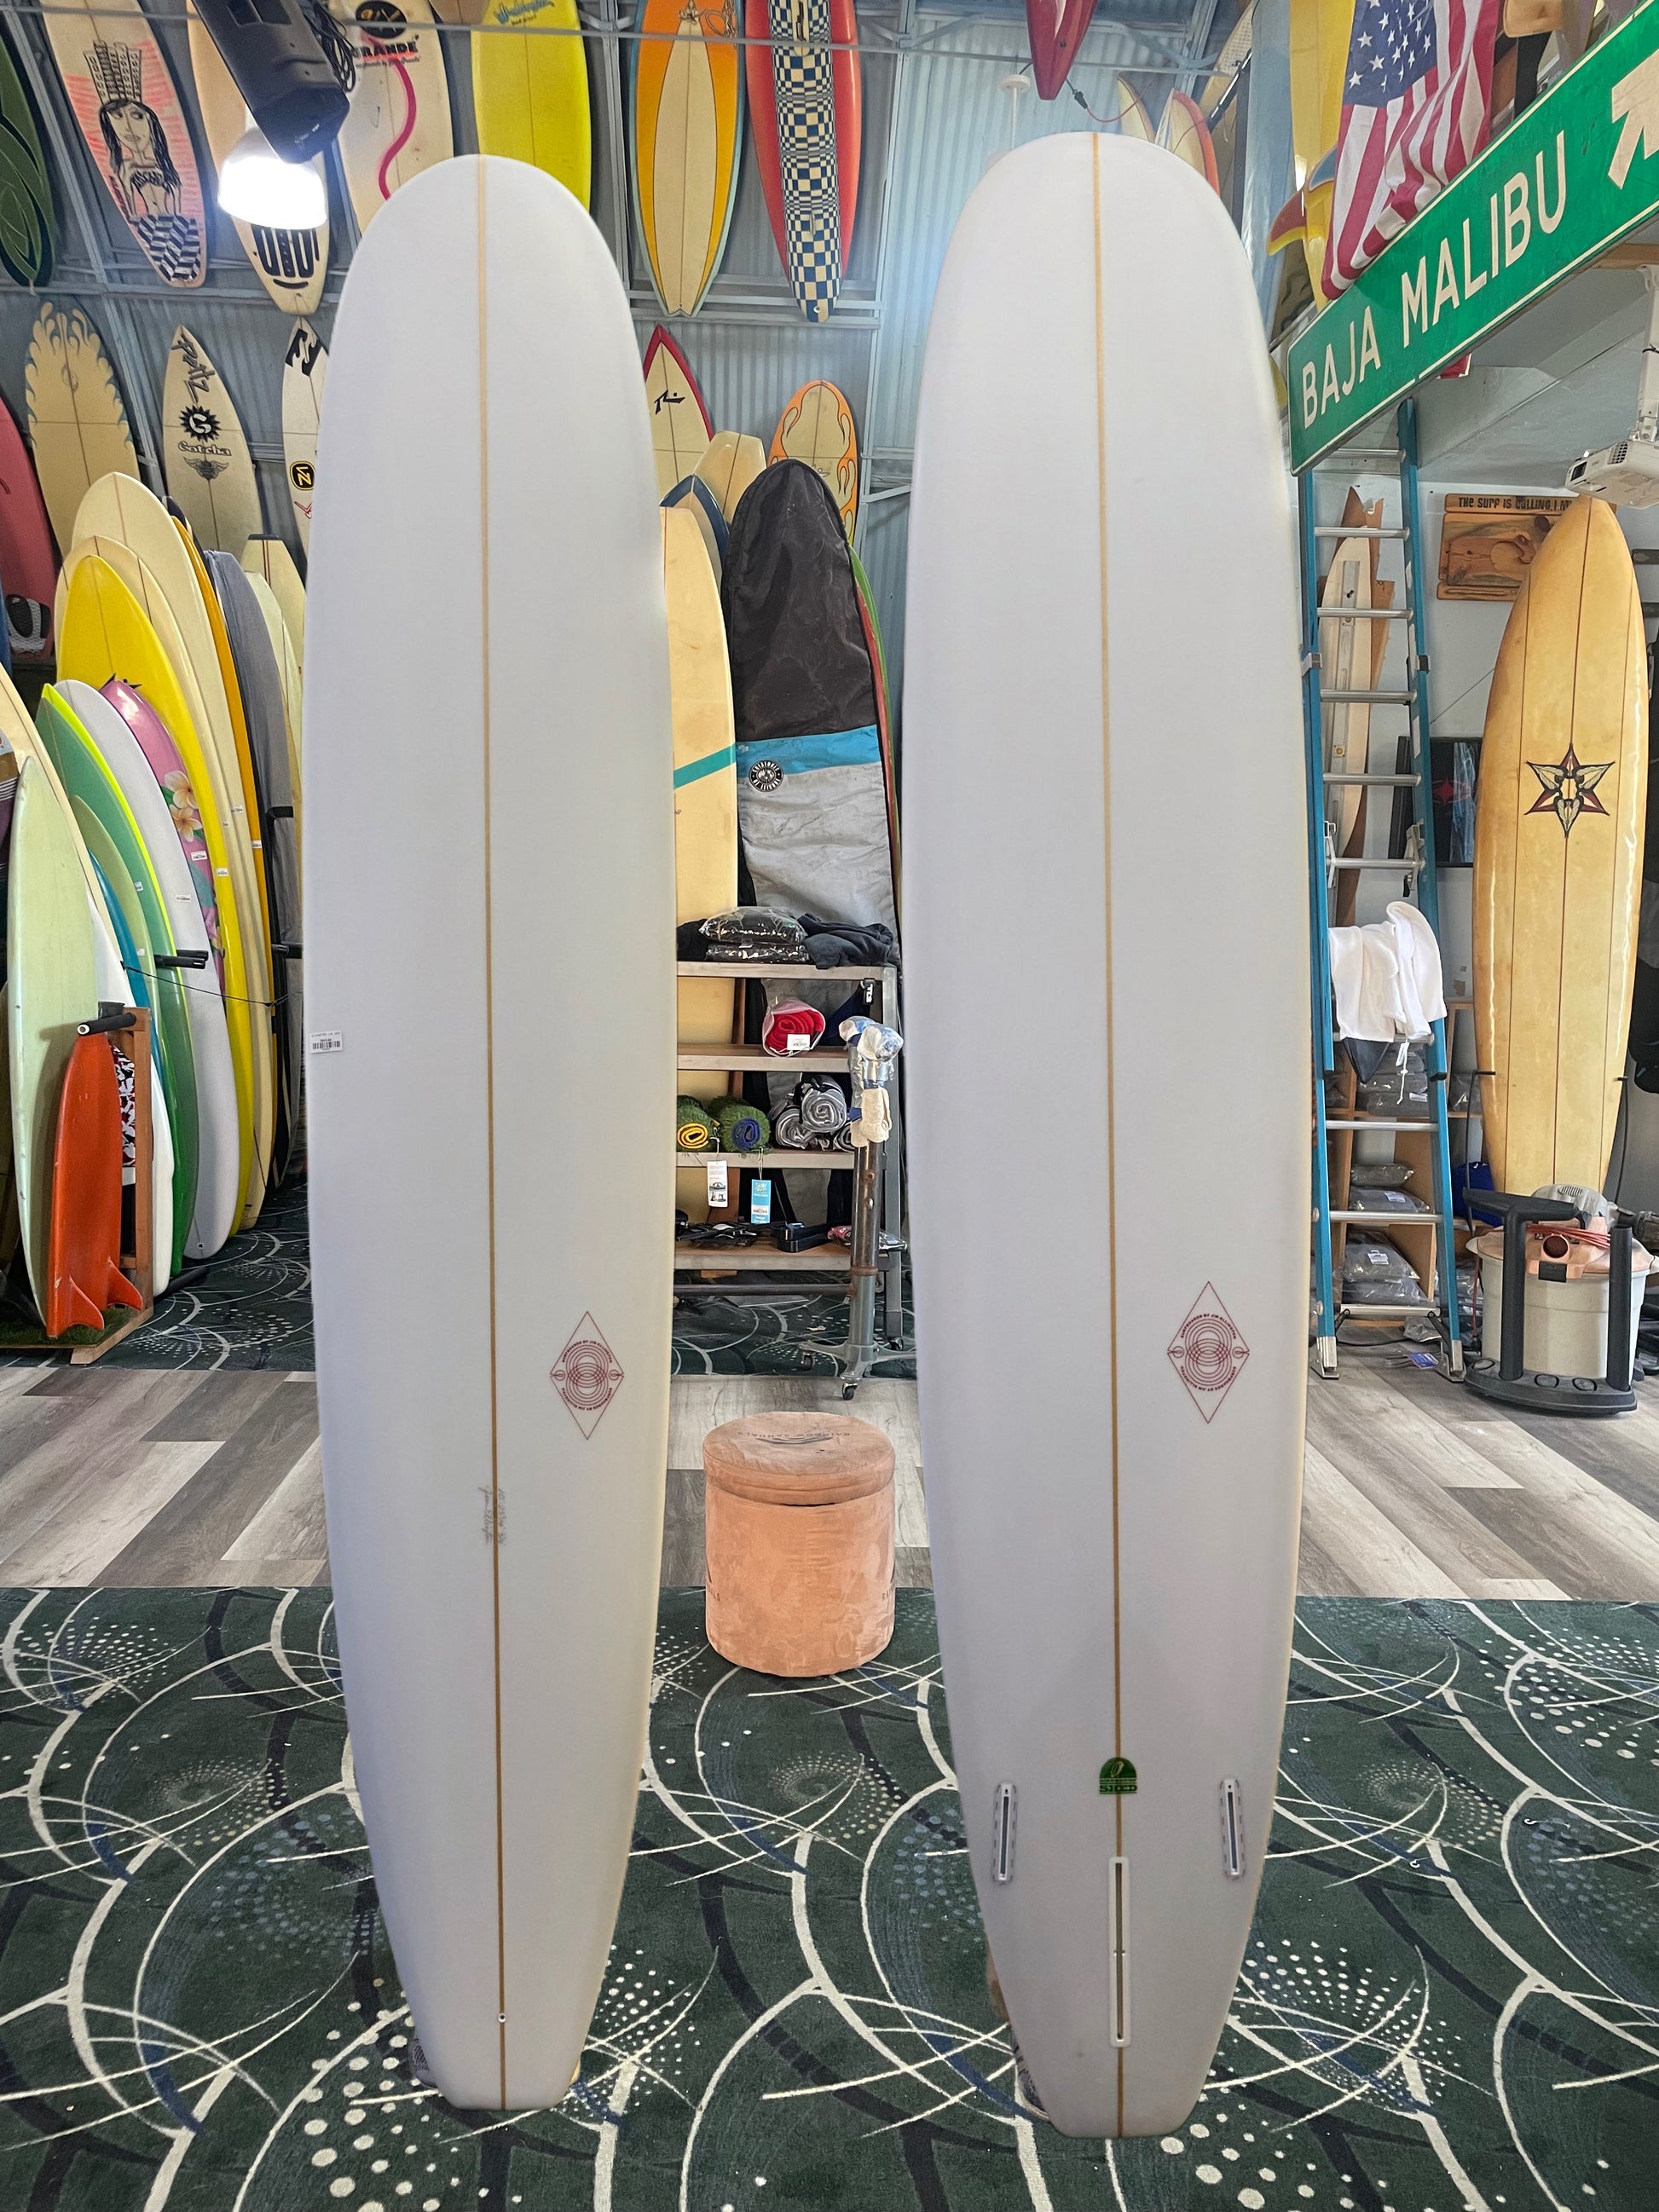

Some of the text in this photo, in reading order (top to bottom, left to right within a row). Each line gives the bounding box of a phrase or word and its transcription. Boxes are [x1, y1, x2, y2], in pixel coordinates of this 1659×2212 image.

[354, 41, 419, 59] RANDE
[1302, 130, 1567, 430] BAJA MALIBU
[178, 441, 232, 456] Gotcha
